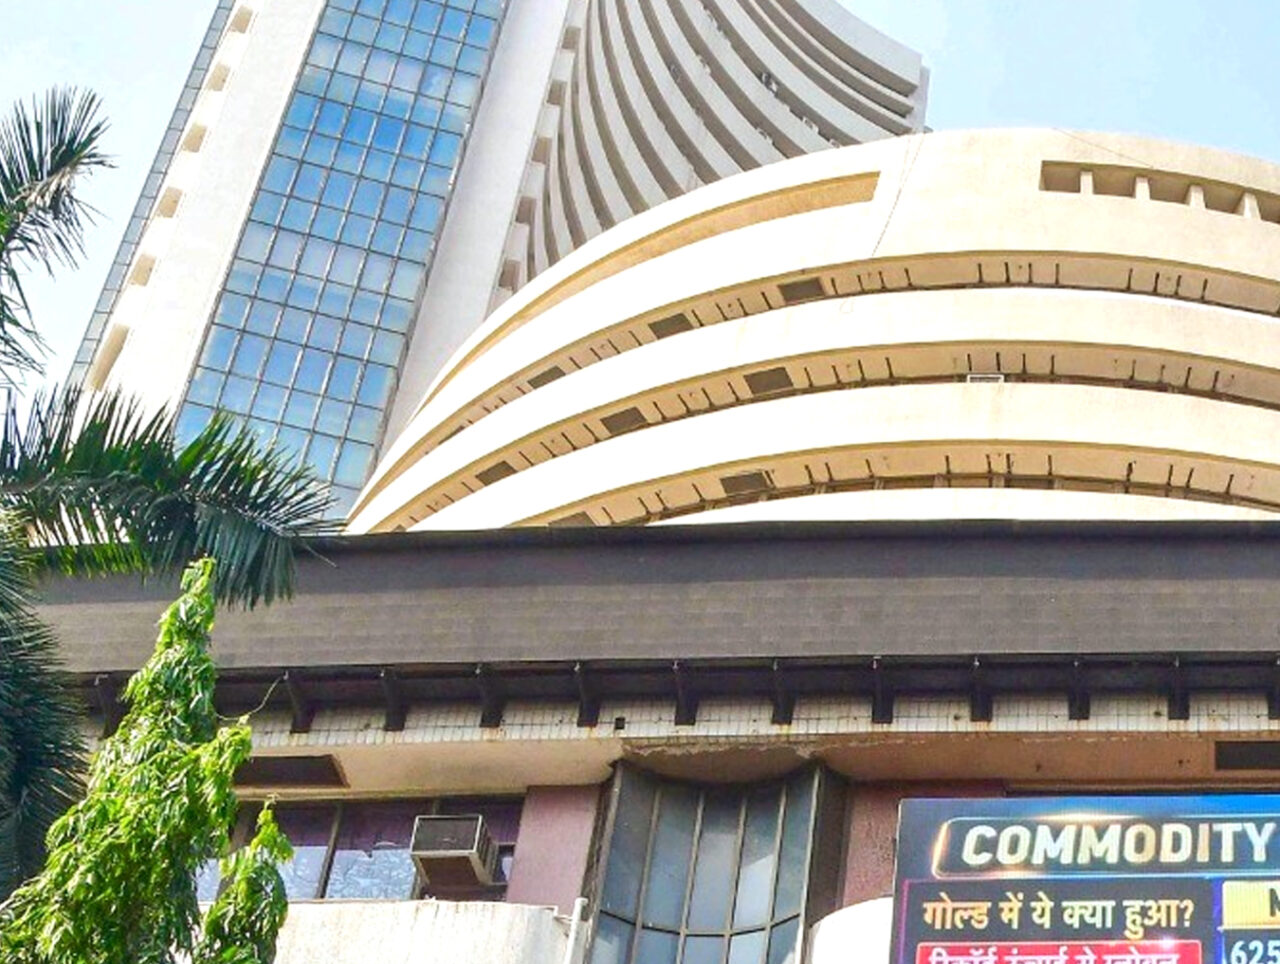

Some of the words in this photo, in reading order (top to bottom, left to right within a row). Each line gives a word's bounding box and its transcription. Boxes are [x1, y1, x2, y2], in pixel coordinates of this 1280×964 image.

[961, 822, 1276, 865] COMMODITY
[923, 892, 991, 930] गोल्ड
[1000, 892, 1024, 930] में
[1031, 891, 1053, 929] ये
[1063, 900, 1116, 929] क्या
[1123, 899, 1194, 938] हुआ?
